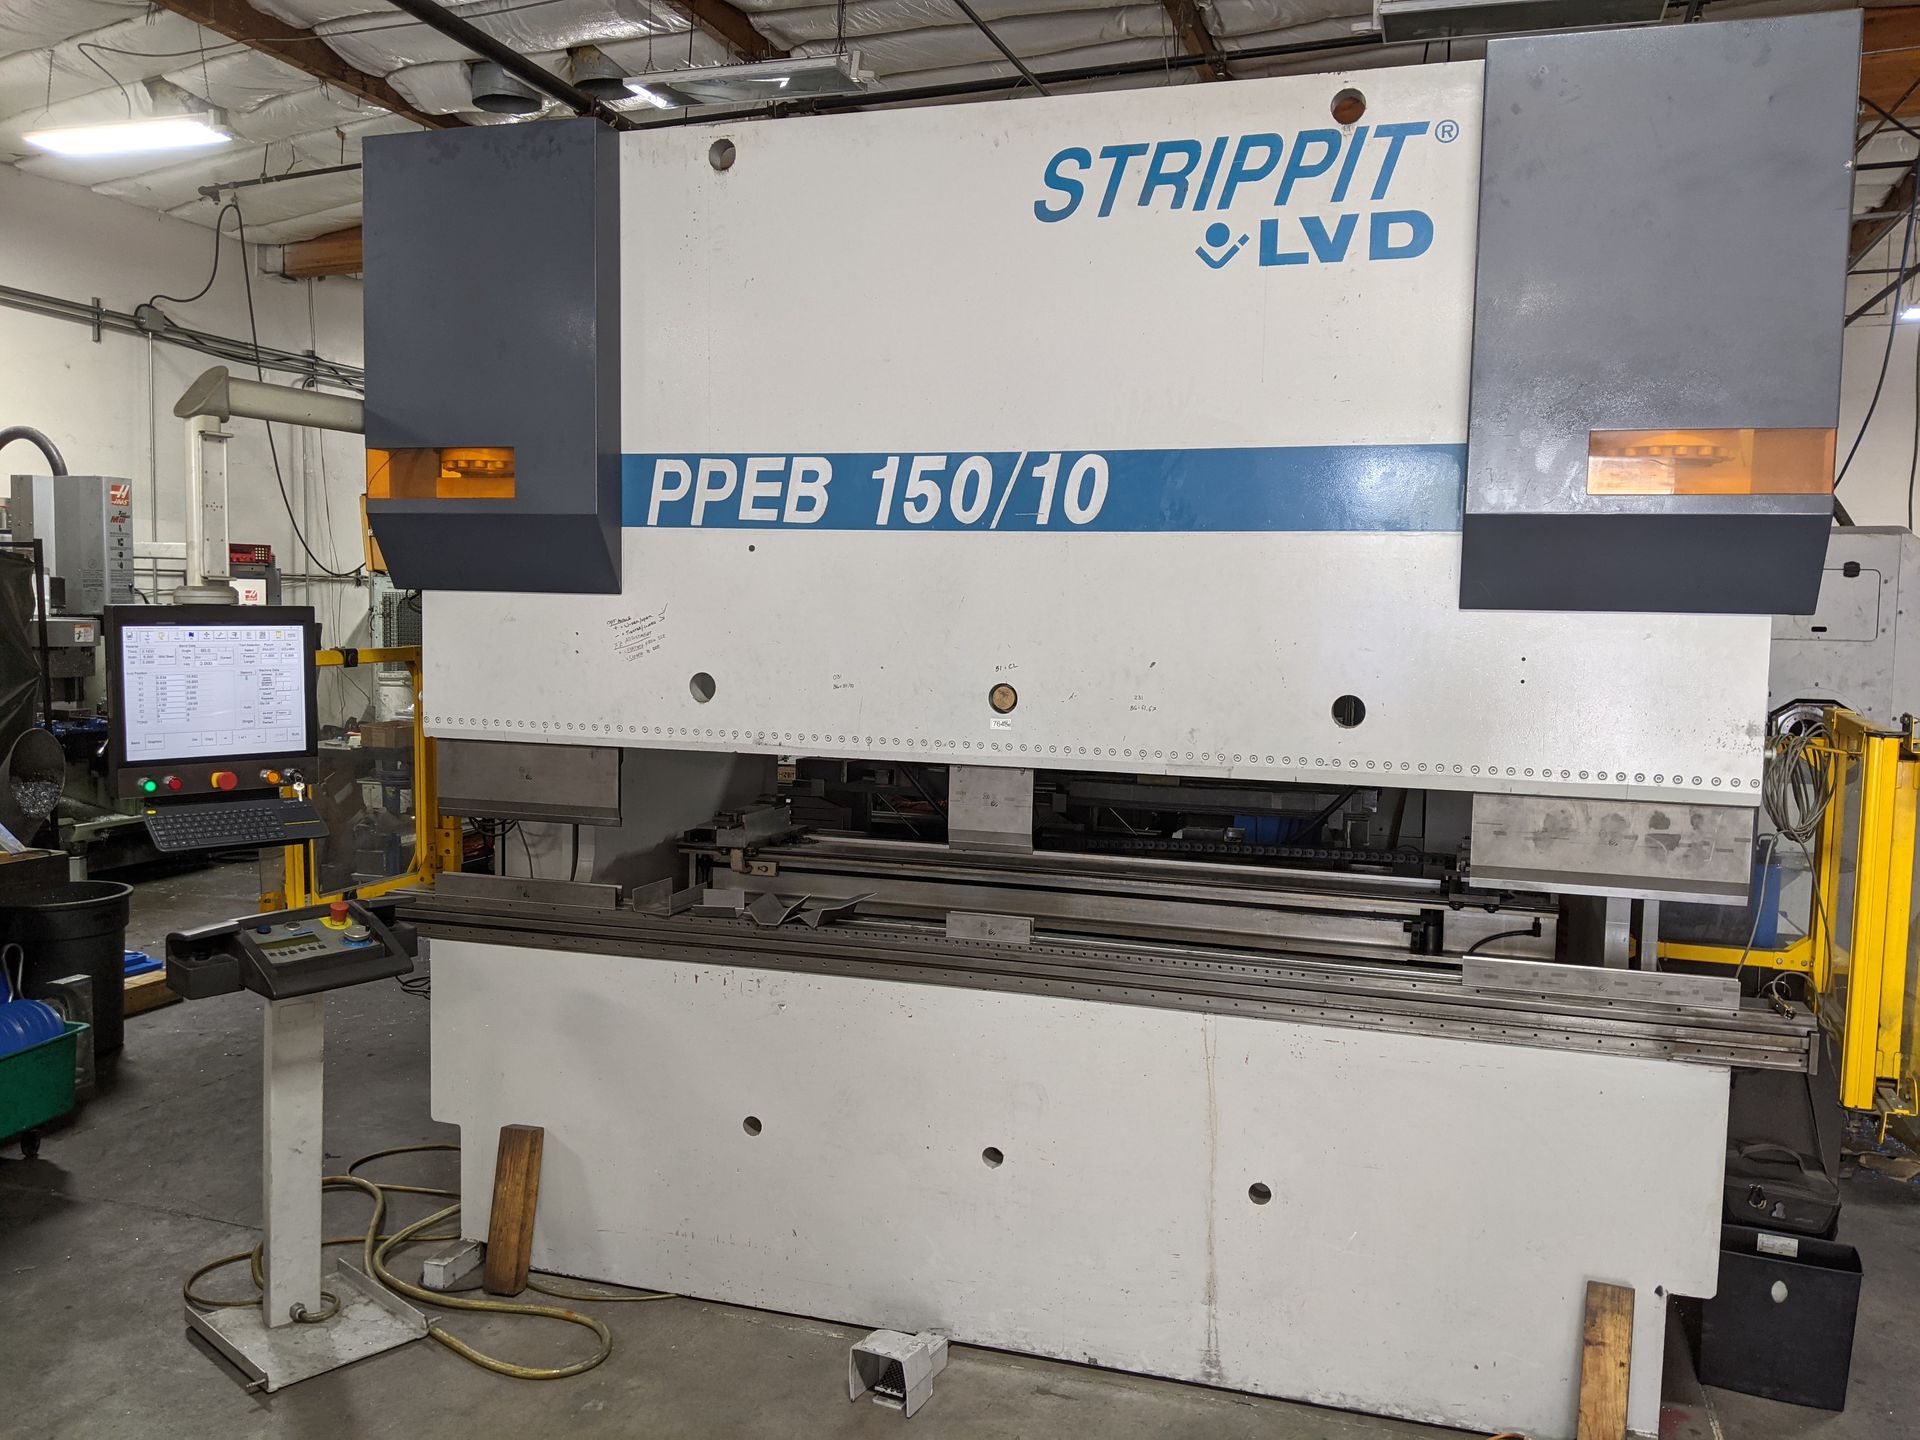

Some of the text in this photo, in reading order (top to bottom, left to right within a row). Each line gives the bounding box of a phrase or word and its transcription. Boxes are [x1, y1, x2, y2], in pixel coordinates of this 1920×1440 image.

[1033, 120, 1431, 223] STRIPPIT
[1258, 209, 1435, 267] LVD
[646, 450, 1109, 530] PPEB 150/10
